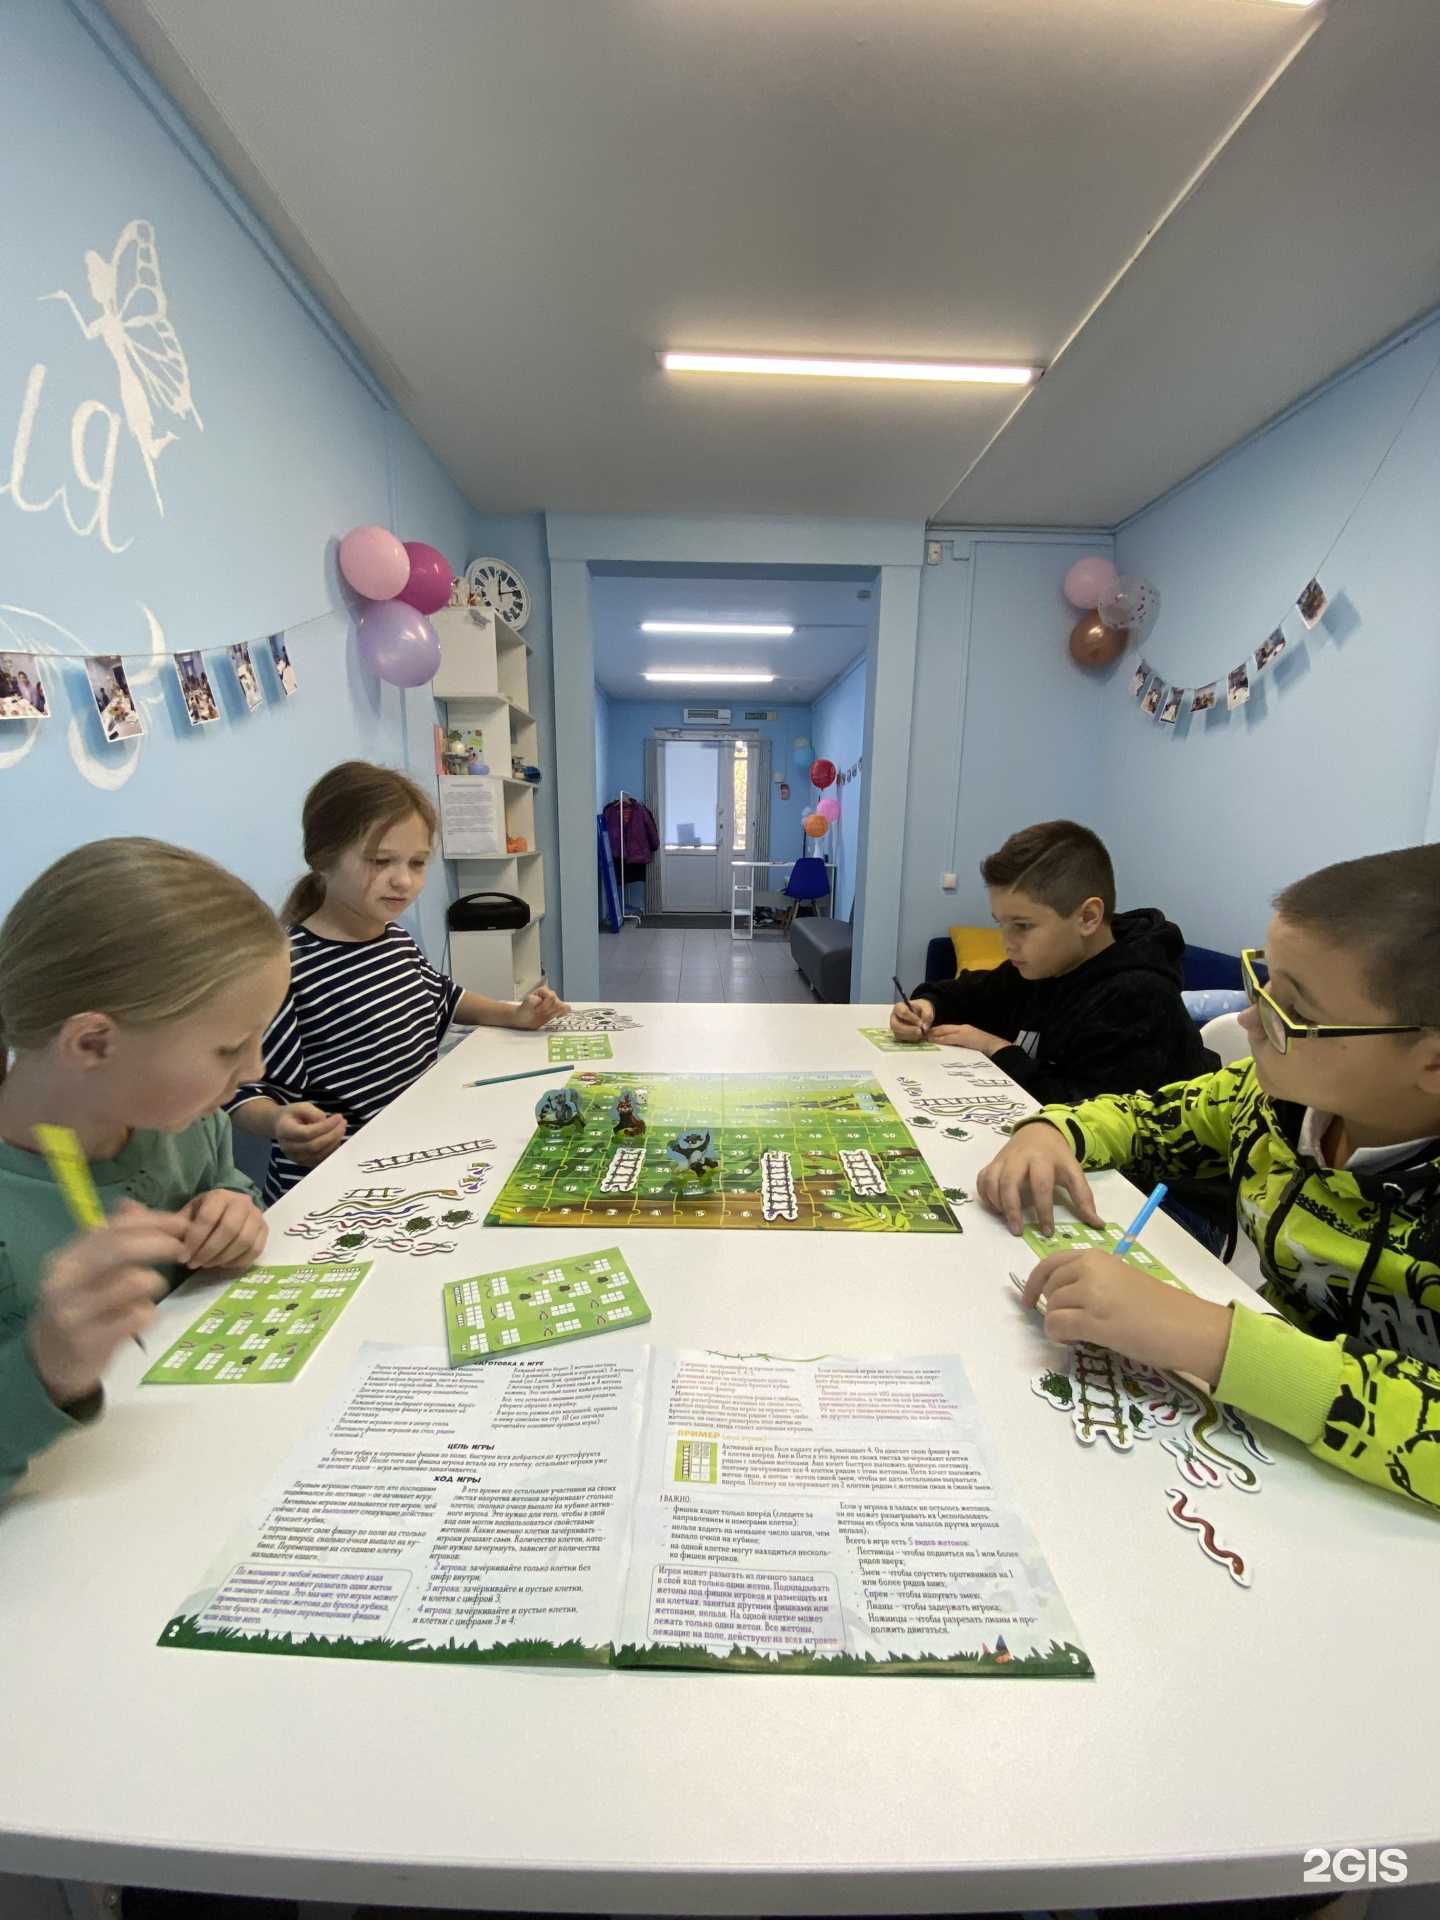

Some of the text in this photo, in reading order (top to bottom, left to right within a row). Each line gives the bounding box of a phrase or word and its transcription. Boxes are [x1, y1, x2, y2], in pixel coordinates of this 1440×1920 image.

[677, 1428, 720, 1438] ПРИМЕР
[672, 1504, 699, 1516] фишки
[699, 1508, 720, 1517] ходят
[772, 1508, 804, 1520] (следите
[696, 1525, 723, 1535] ходить
[790, 1529, 814, 1539] шагов,
[856, 1547, 894, 1558] Лестницы
[901, 1547, 925, 1556] чтобы
[925, 1550, 964, 1559] подняться
[996, 1549, 1019, 1558] более
[577, 1563, 591, 1571] без
[858, 1558, 881, 1567] рядов
[429, 1572, 452, 1583] цифр
[658, 1566, 681, 1578] Игрок
[860, 1568, 881, 1576] Змеи
[887, 1568, 912, 1577] чтобы
[913, 1570, 947, 1579] спустить
[948, 1571, 997, 1580] противников
[524, 1586, 553, 1594] пустые
[554, 1586, 581, 1594] клетки,
[663, 1576, 681, 1585] свой
[682, 1579, 696, 1588] ход
[724, 1581, 745, 1590] один
[772, 1581, 830, 1594] Подкладывать
[461, 1593, 494, 1604] цифрой
[687, 1589, 703, 1598] под
[703, 1588, 732, 1600] фишки
[733, 1591, 765, 1601] игроков
[773, 1593, 817, 1603] размещать
[896, 1589, 921, 1598] чтобы
[922, 1592, 958, 1601] напугать
[518, 1607, 547, 1615] пустые
[548, 1607, 576, 1615] клетки,
[666, 1598, 701, 1608] клетках,
[736, 1601, 771, 1611] другими
[772, 1601, 813, 1613] фишками
[866, 1601, 893, 1610] Лианы
[901, 1602, 927, 1610] чтобы
[927, 1604, 970, 1613] задержать
[654, 1608, 696, 1618] жетонами,
[729, 1609, 741, 1618] На
[741, 1610, 767, 1621] одной
[868, 1614, 907, 1624] Ножницы
[915, 1614, 941, 1622] чтобы
[942, 1616, 983, 1625] разрезать
[1019, 1617, 1038, 1625] про-
[455, 1615, 493, 1627] цифрами
[713, 1622, 735, 1632] один
[764, 1622, 779, 1632] Все
[779, 1626, 814, 1636] жетоны,
[869, 1627, 906, 1636] должить
[652, 1629, 690, 1639] лежащие
[703, 1631, 724, 1641] поле,
[727, 1630, 772, 1643] действуют
[1069, 1652, 1080, 1664] 3
